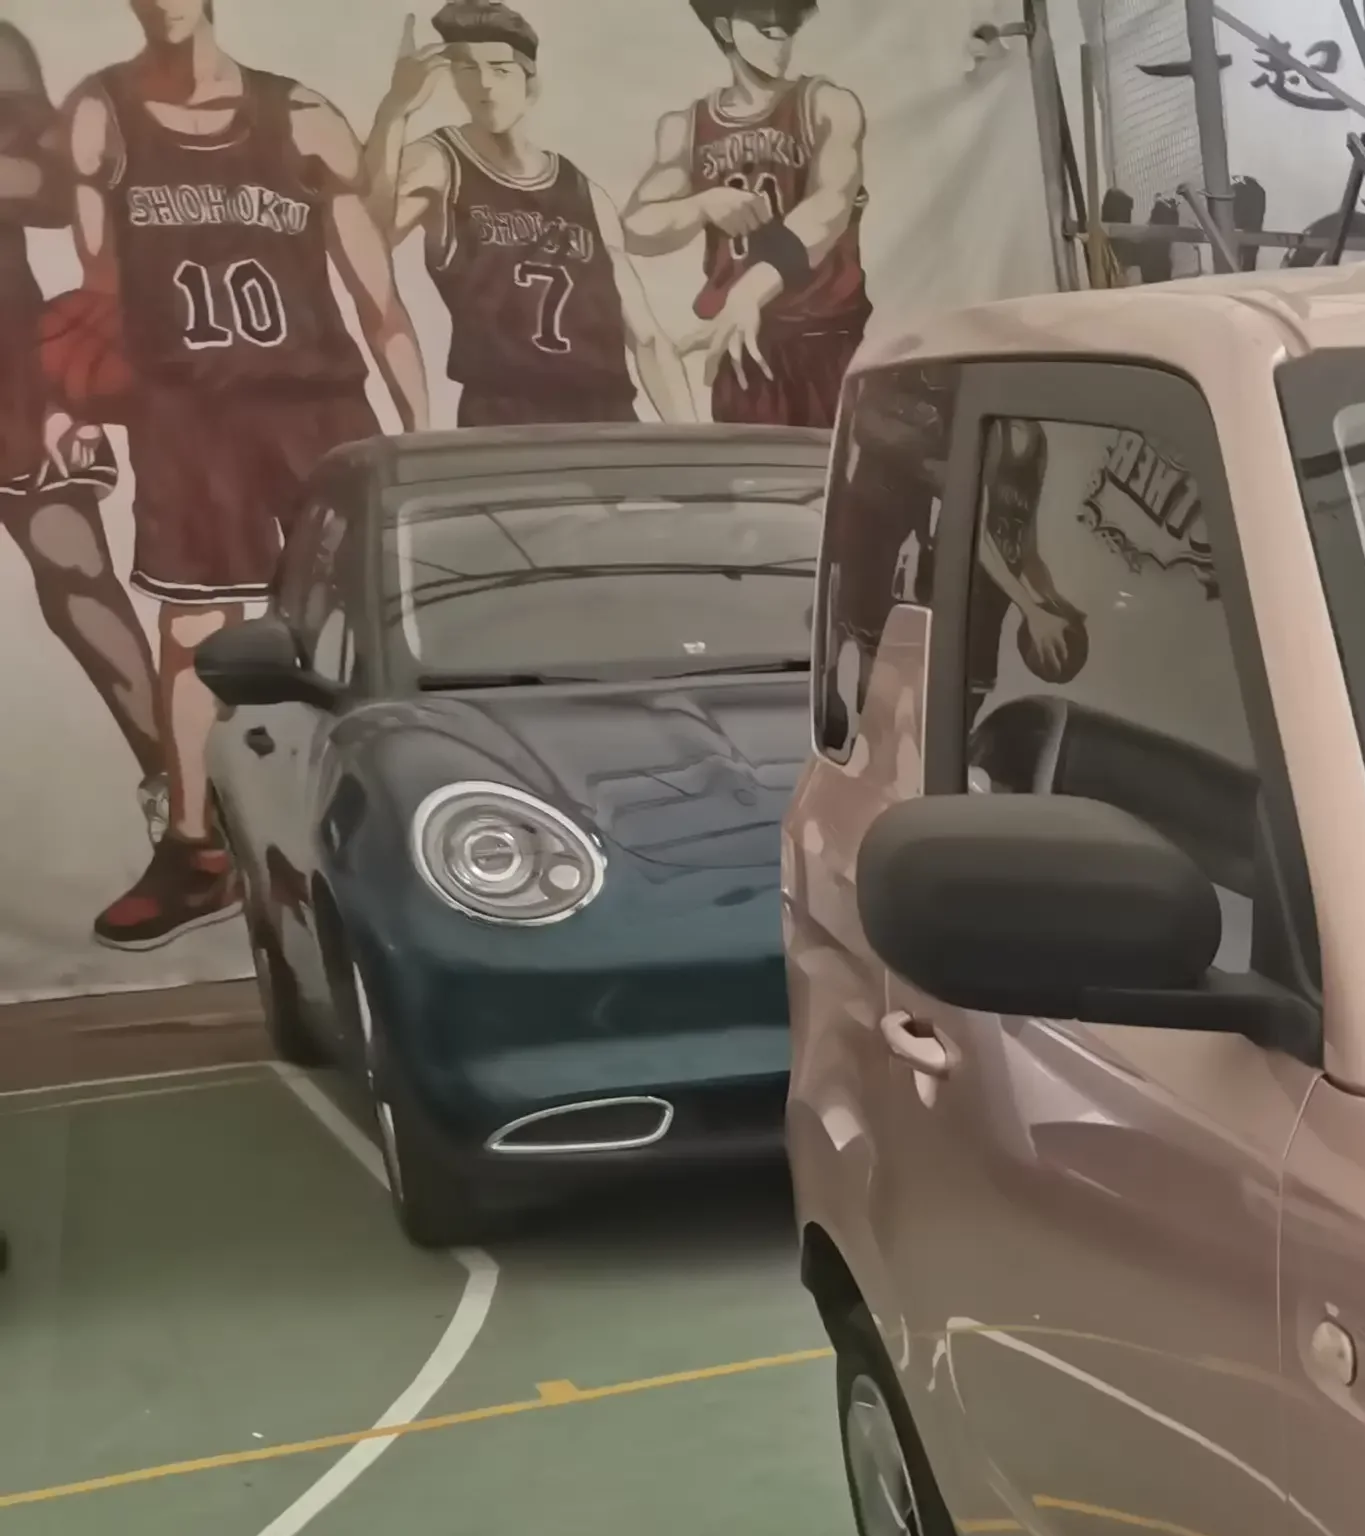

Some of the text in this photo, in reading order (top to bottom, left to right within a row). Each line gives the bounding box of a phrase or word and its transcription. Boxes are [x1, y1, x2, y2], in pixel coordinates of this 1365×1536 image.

[129, 184, 310, 235] SHOHOKU
[173, 258, 287, 349] 10
[514, 260, 574, 353] 7
